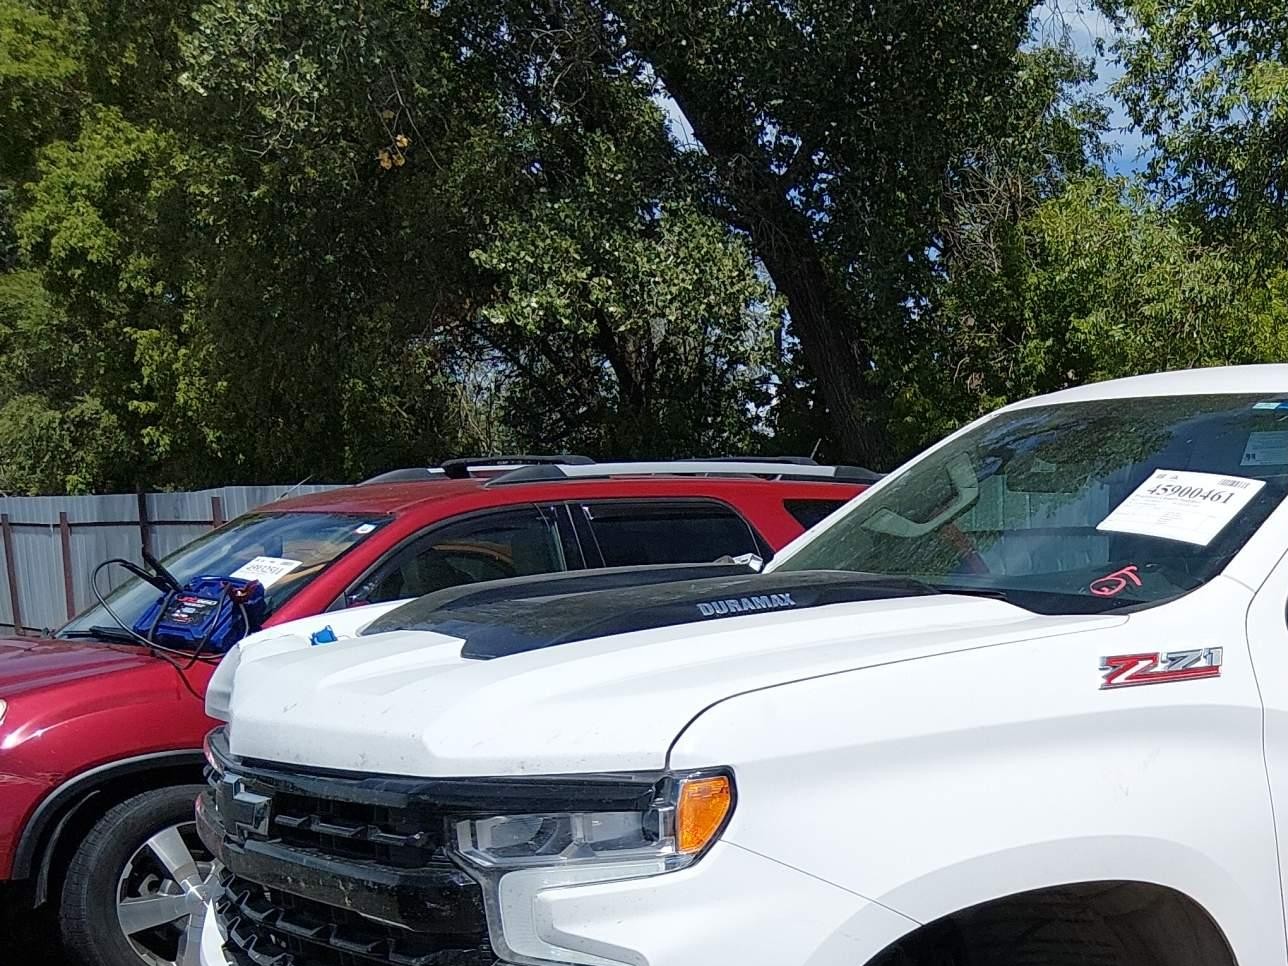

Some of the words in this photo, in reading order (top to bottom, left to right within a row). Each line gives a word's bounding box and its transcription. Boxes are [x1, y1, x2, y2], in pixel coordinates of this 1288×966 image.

[1147, 483, 1236, 504] 45900461
[696, 593, 797, 616] DURAMAX
[1099, 646, 1223, 690] Z71
